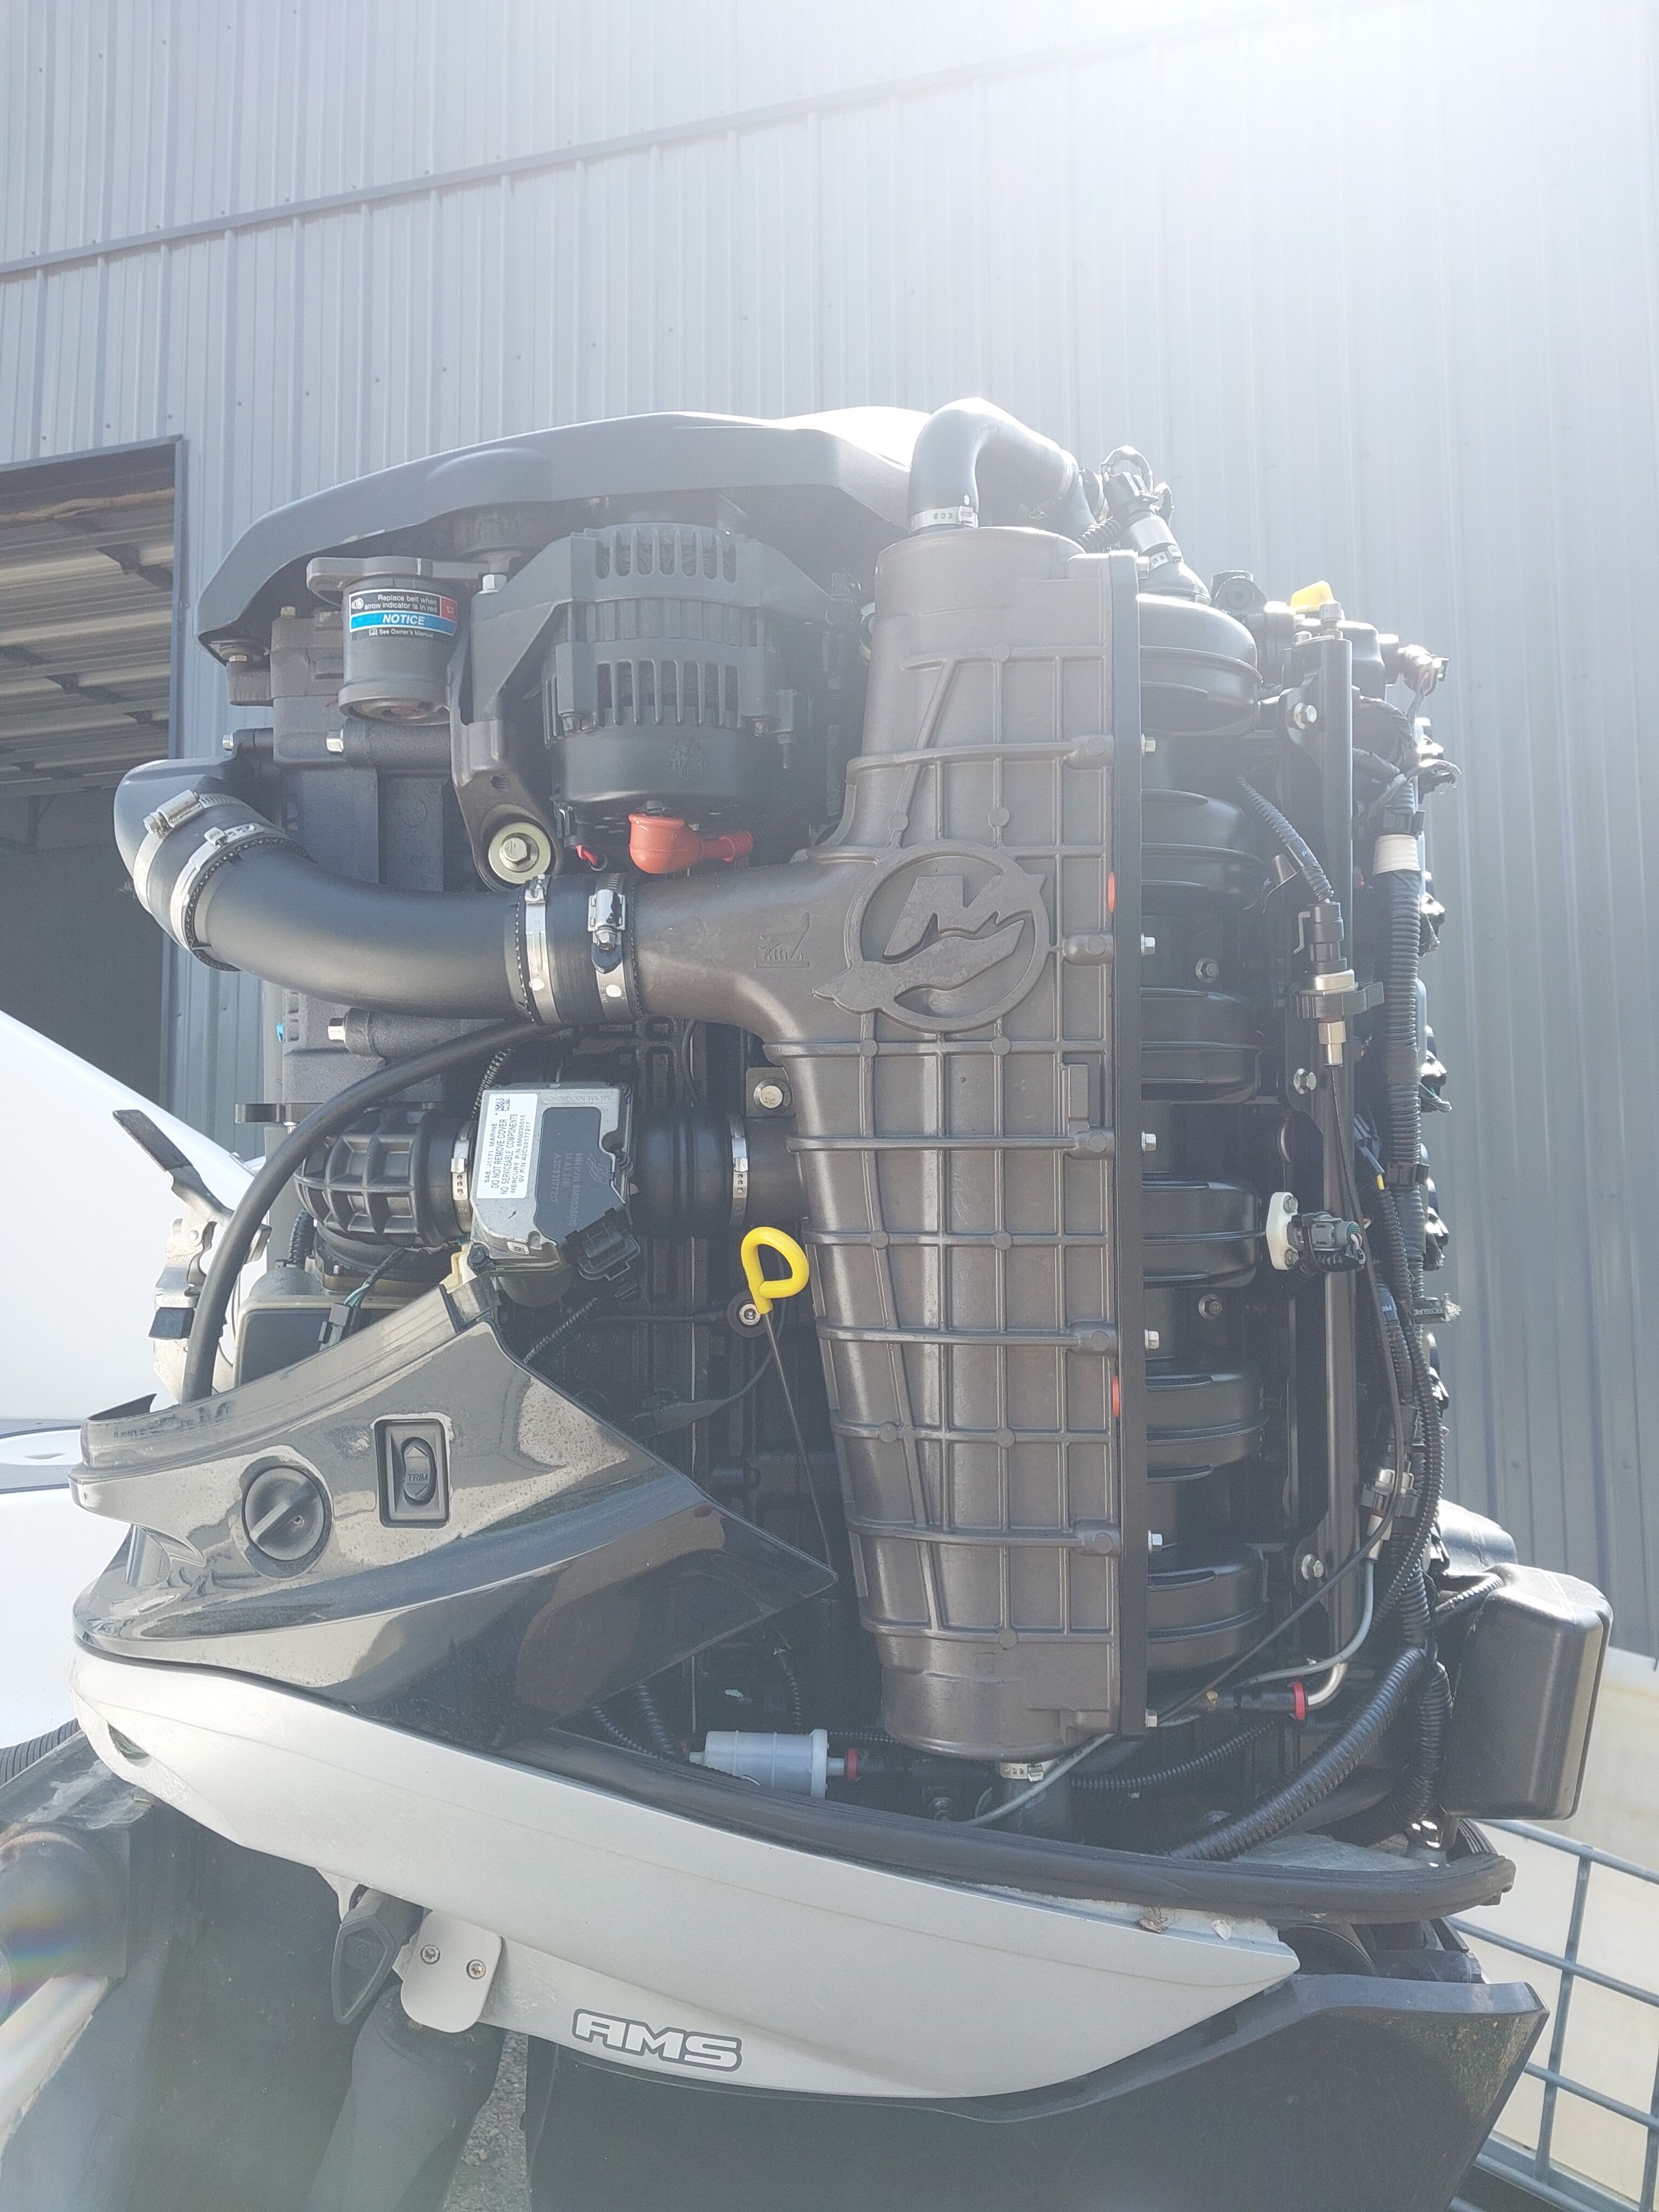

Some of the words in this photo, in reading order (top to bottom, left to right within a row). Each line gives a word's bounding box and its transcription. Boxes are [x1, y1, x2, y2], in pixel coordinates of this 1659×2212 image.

[364, 602, 381, 610] arrow
[427, 605, 438, 613] red
[377, 594, 405, 602] Replace
[421, 597, 438, 606] when
[382, 614, 426, 626] NOTICE
[415, 630, 434, 638] Manual
[489, 1123, 497, 1147] MARINE
[498, 1119, 507, 1139] COVER
[506, 1114, 518, 1148] COMPONENTS
[522, 1122, 531, 1161] A2C53177217
[494, 1140, 505, 1165] REMOVE
[511, 1162, 520, 1193] MERCURY
[516, 1114, 525, 1147] 8M0035015
[493, 1166, 501, 1176] NOT
[502, 1150, 513, 1185] SERVICEABLE
[491, 1178, 500, 1188] DO
[408, 1473, 429, 1482] TRIM
[574, 2010, 741, 2070] AMS
